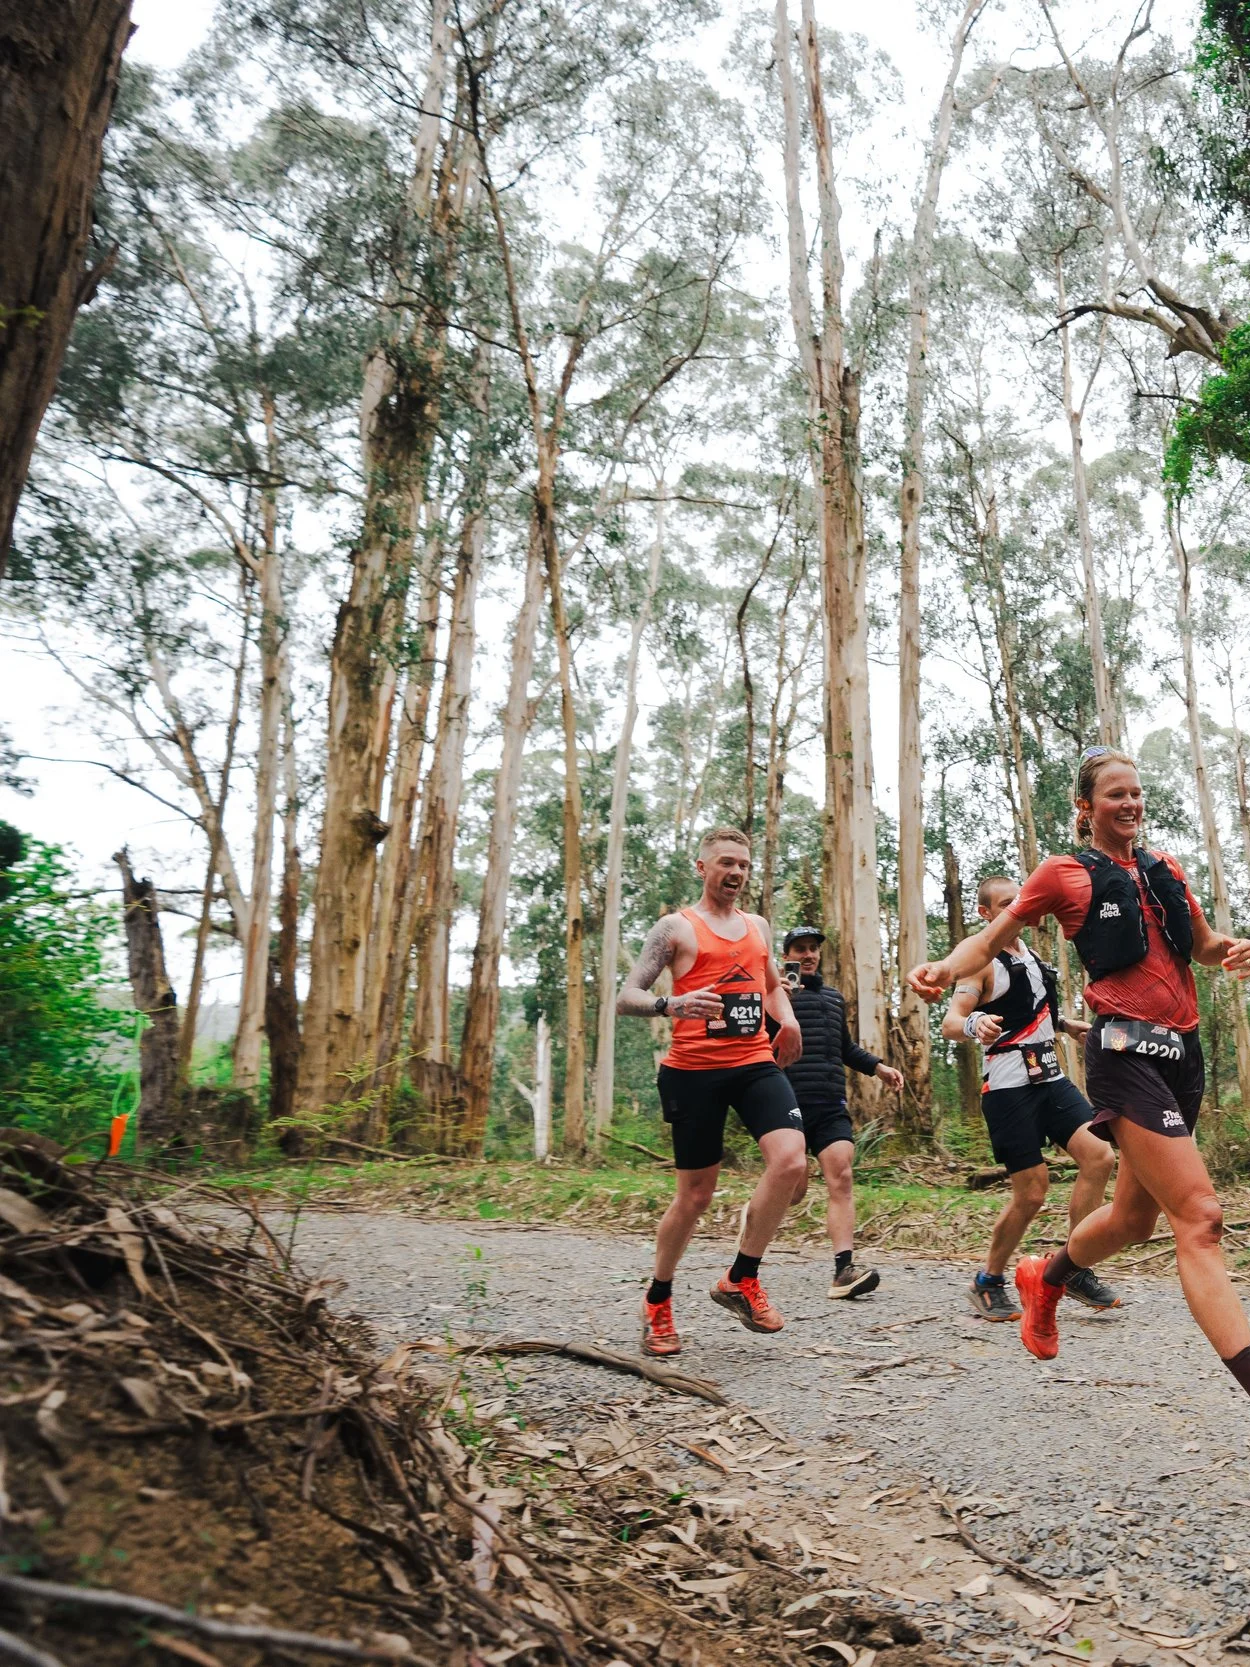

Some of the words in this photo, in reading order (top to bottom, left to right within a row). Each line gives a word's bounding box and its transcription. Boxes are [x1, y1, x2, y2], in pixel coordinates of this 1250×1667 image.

[1102, 902, 1118, 911] The
[1100, 908, 1121, 919] Feed.
[730, 1005, 761, 1019] 4214
[1136, 1040, 1180, 1060] 4220
[1163, 1110, 1180, 1119] The
